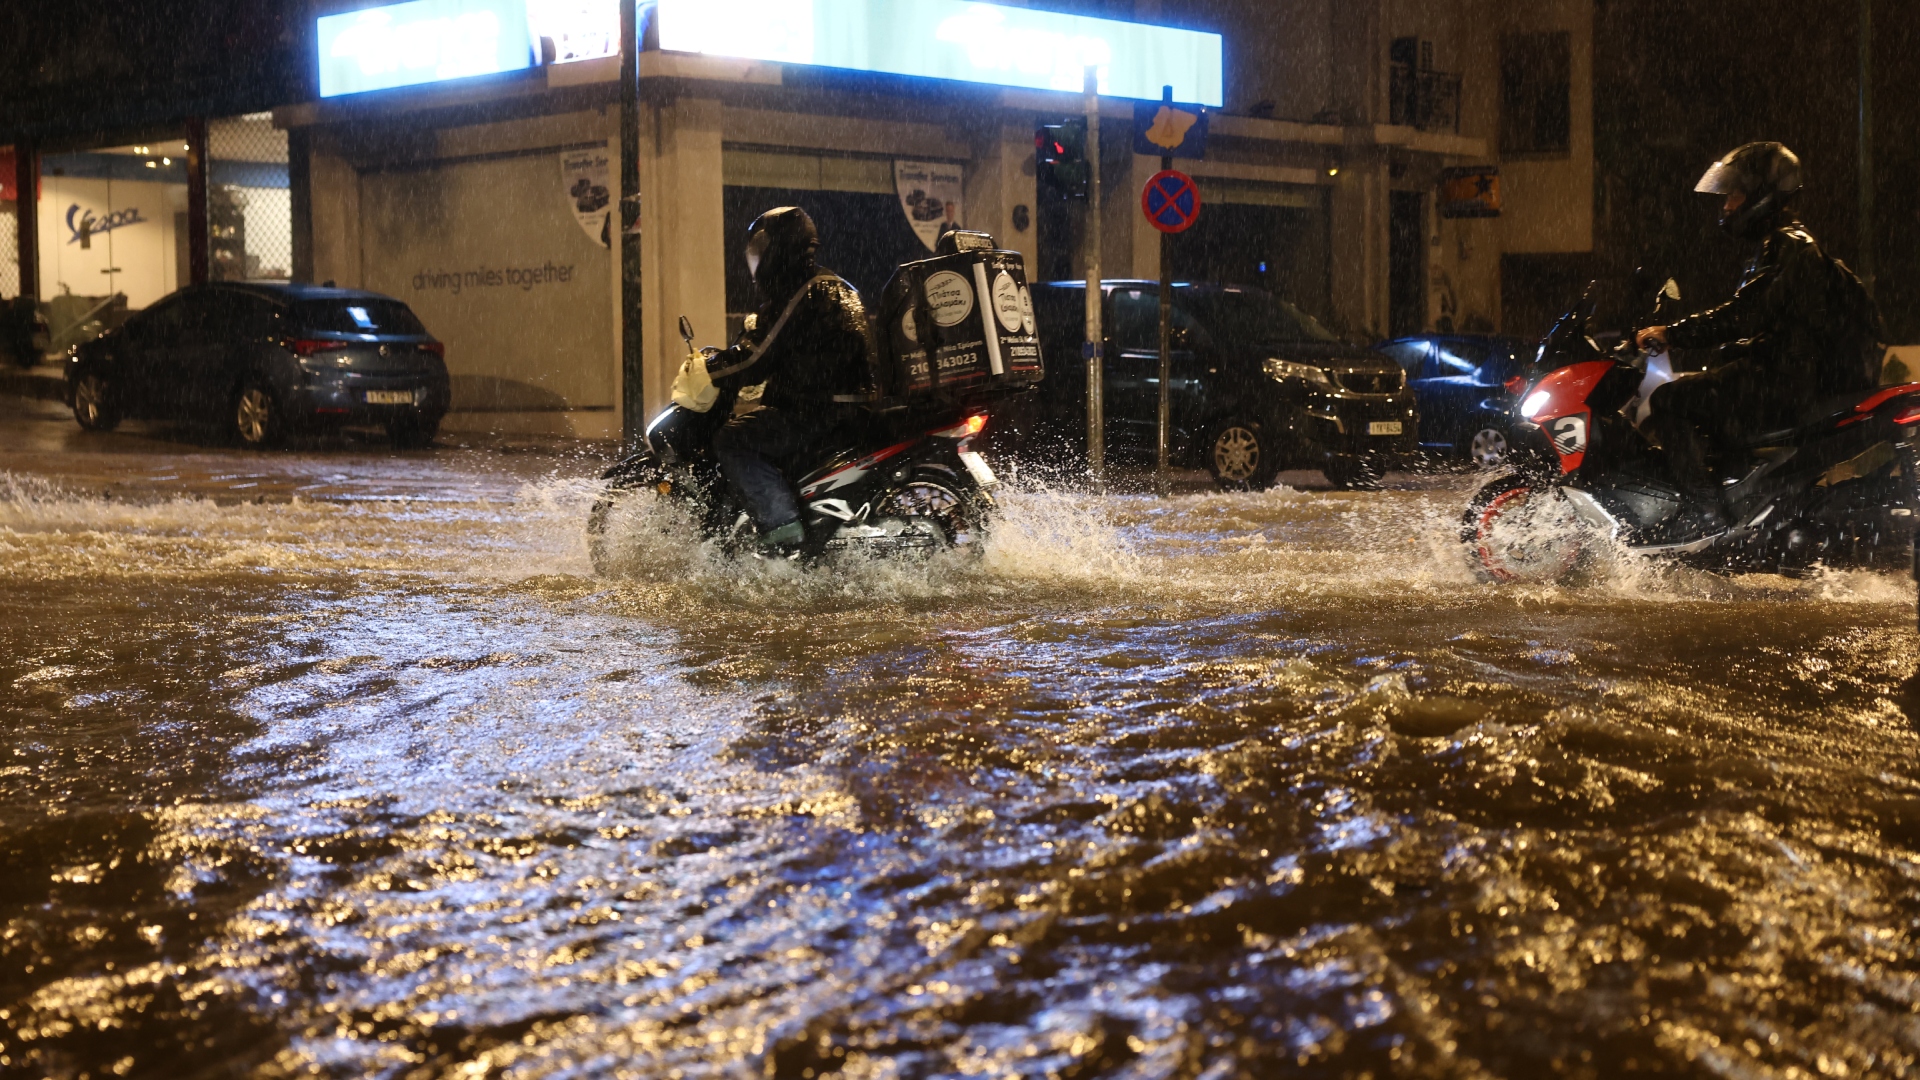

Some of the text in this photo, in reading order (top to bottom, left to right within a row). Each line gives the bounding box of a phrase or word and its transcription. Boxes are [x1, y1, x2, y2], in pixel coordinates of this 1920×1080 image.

[66, 203, 147, 246] Vespa
[412, 260, 574, 295] driving miles together
[1554, 416, 1587, 456] a
